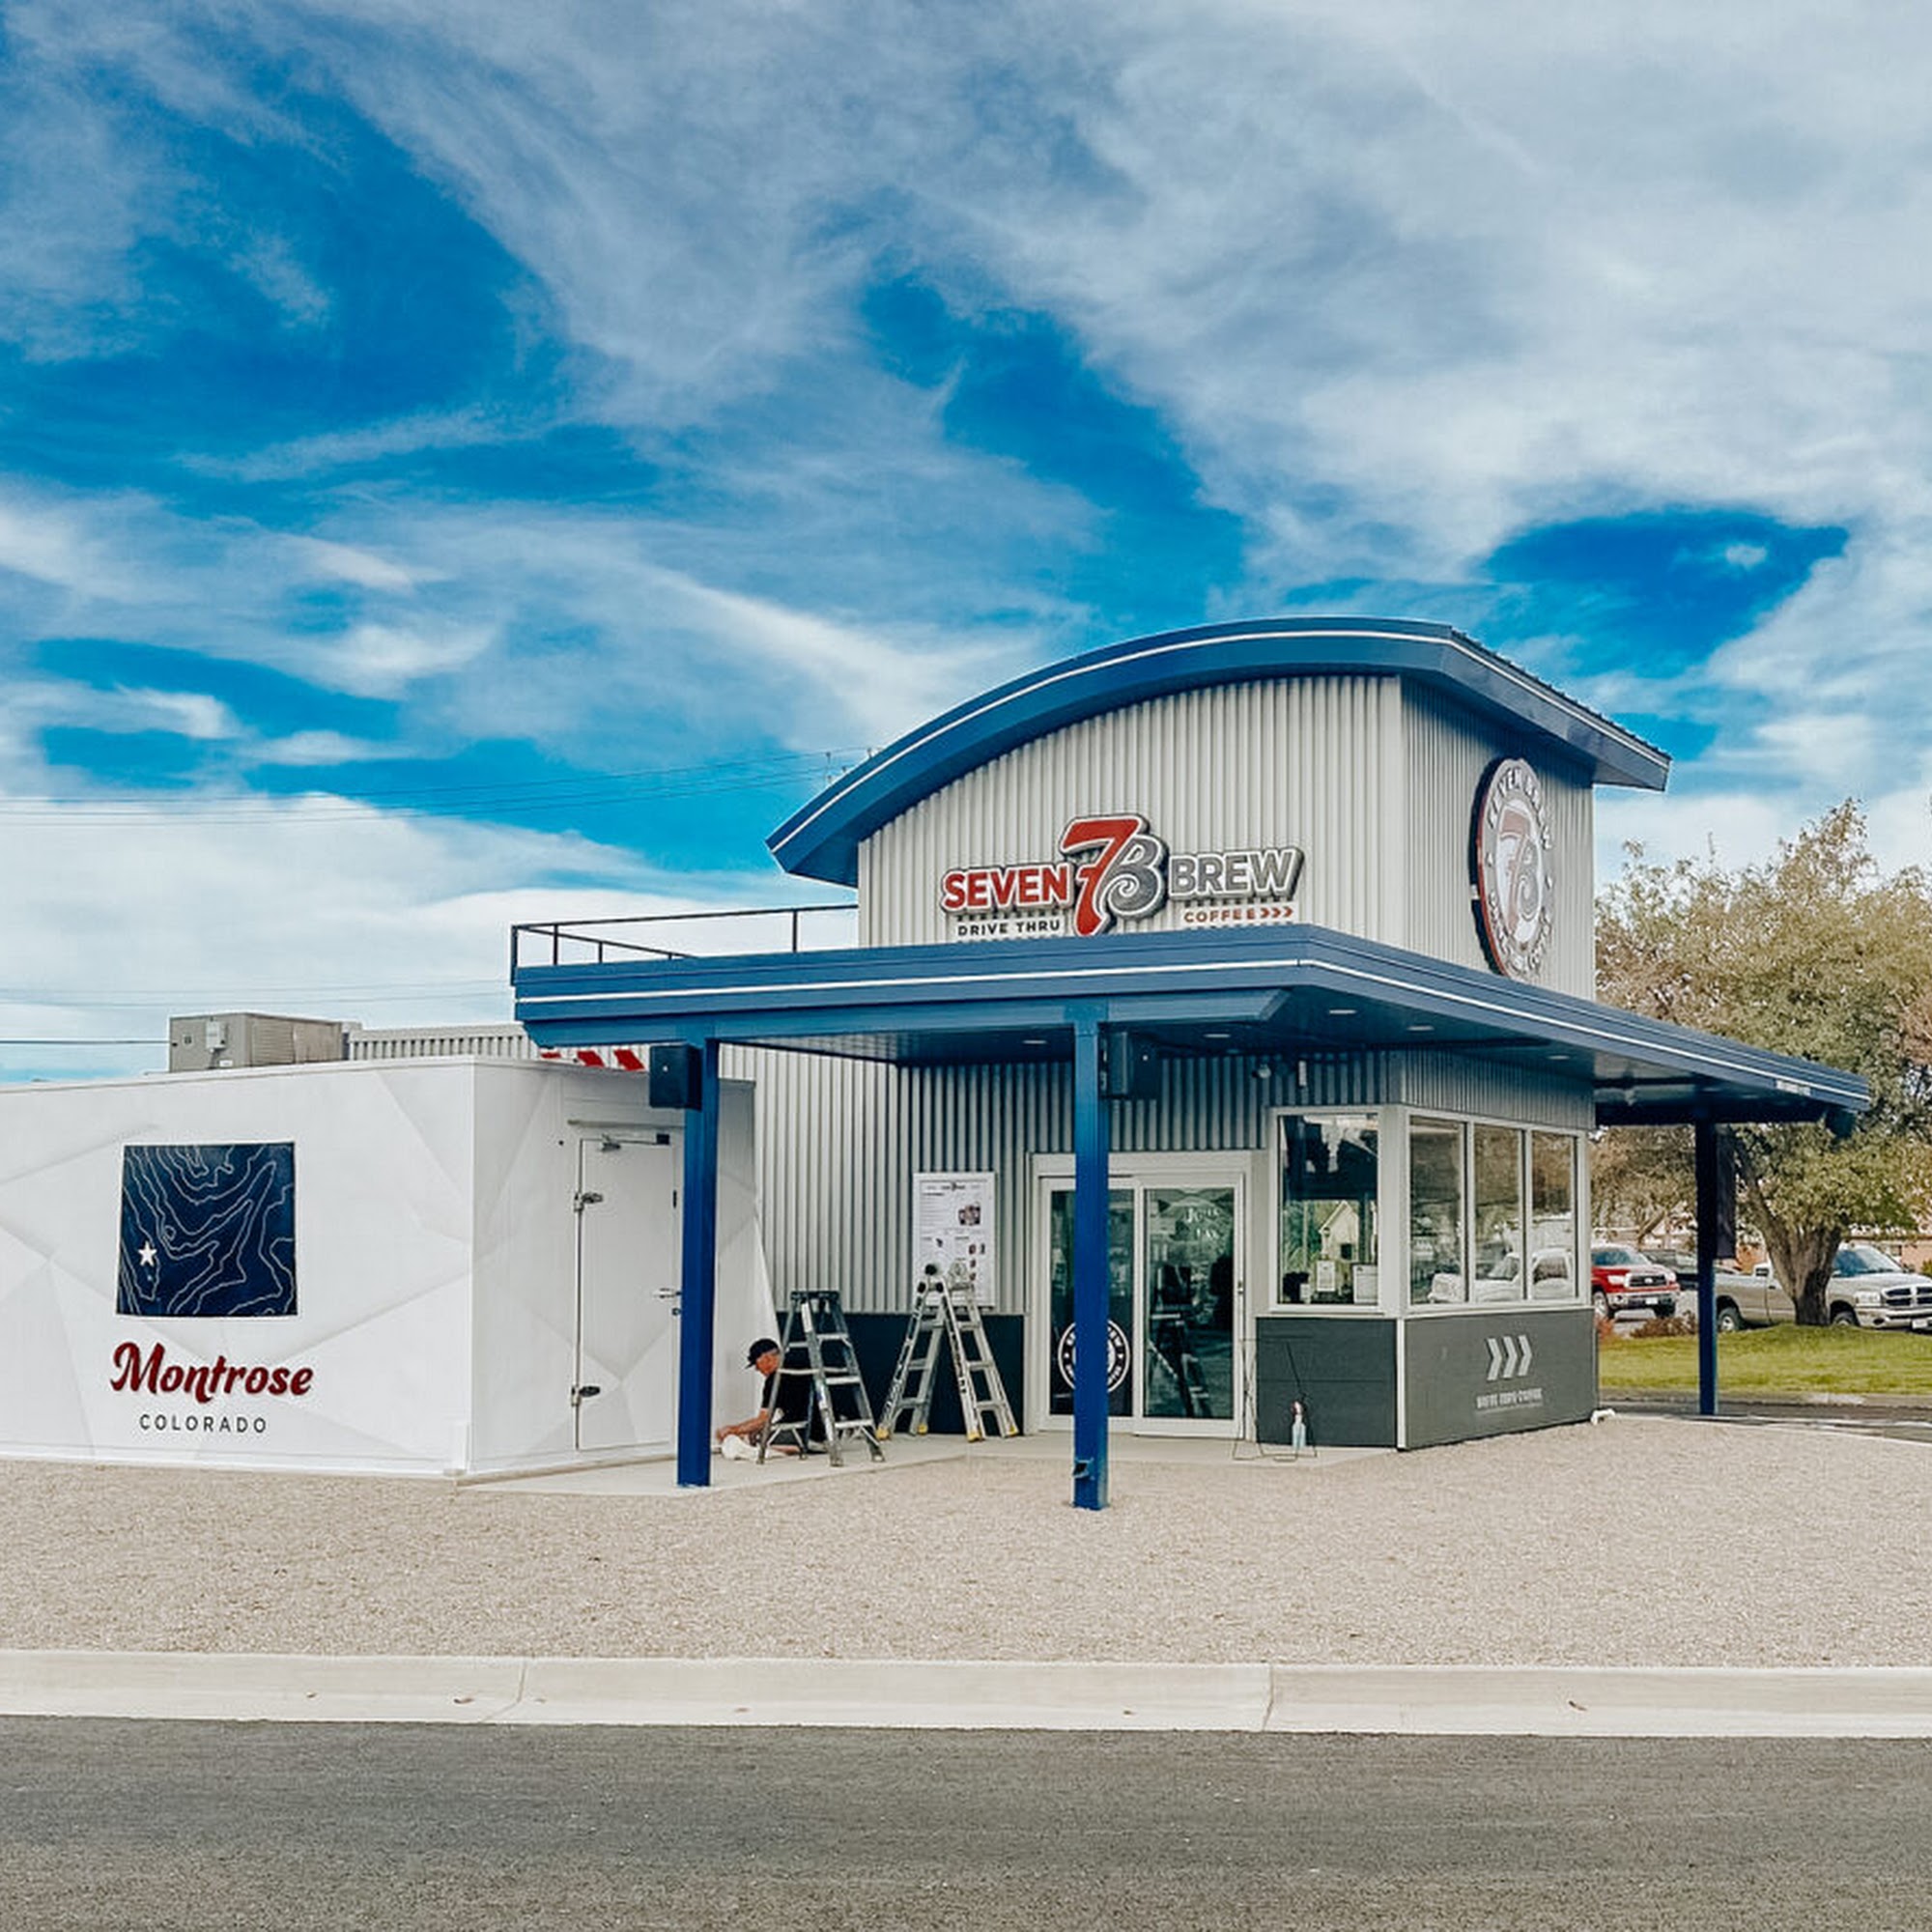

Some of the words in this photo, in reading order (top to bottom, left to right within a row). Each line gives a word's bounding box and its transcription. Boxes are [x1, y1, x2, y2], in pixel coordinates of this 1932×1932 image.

[943, 865, 1068, 909] SEVEN
[1171, 849, 1295, 895] BREW
[1183, 906, 1256, 923] COFFEE
[957, 921, 1009, 936] DRIVE
[1015, 919, 1061, 934] THRU
[110, 1341, 314, 1403] Montrose
[139, 1413, 267, 1434] COLORADO
